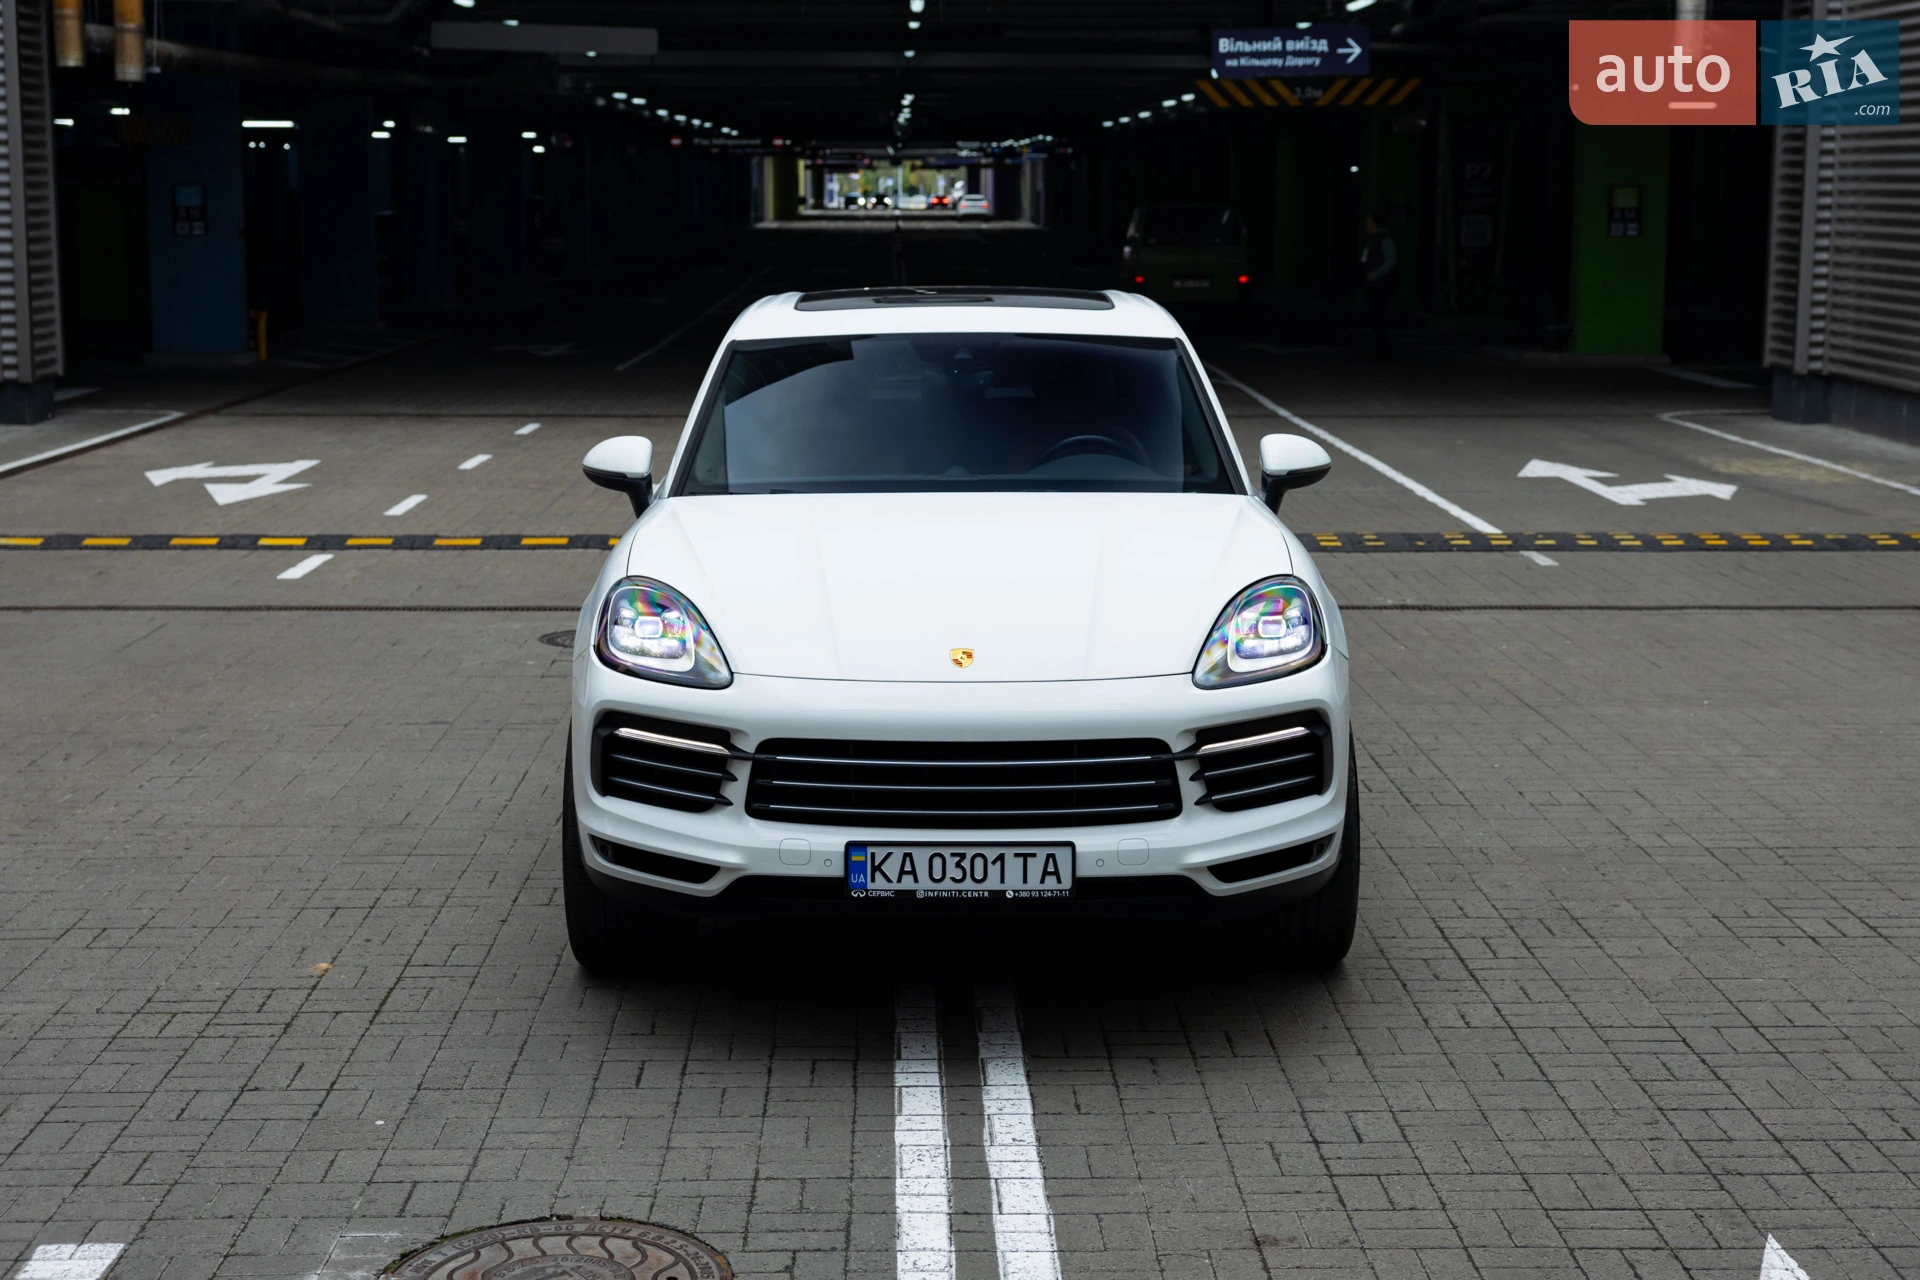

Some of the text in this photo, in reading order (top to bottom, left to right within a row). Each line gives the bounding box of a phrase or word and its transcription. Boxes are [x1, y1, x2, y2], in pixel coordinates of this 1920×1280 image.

[1218, 36, 1330, 53] Вільний виїзд
[1225, 55, 1322, 68] на Кільцеву Дорогу
[870, 852, 1062, 884] KA 0301 TA
[851, 873, 866, 883] UA
[1014, 890, 1070, 898] +380 93 124-71-11
